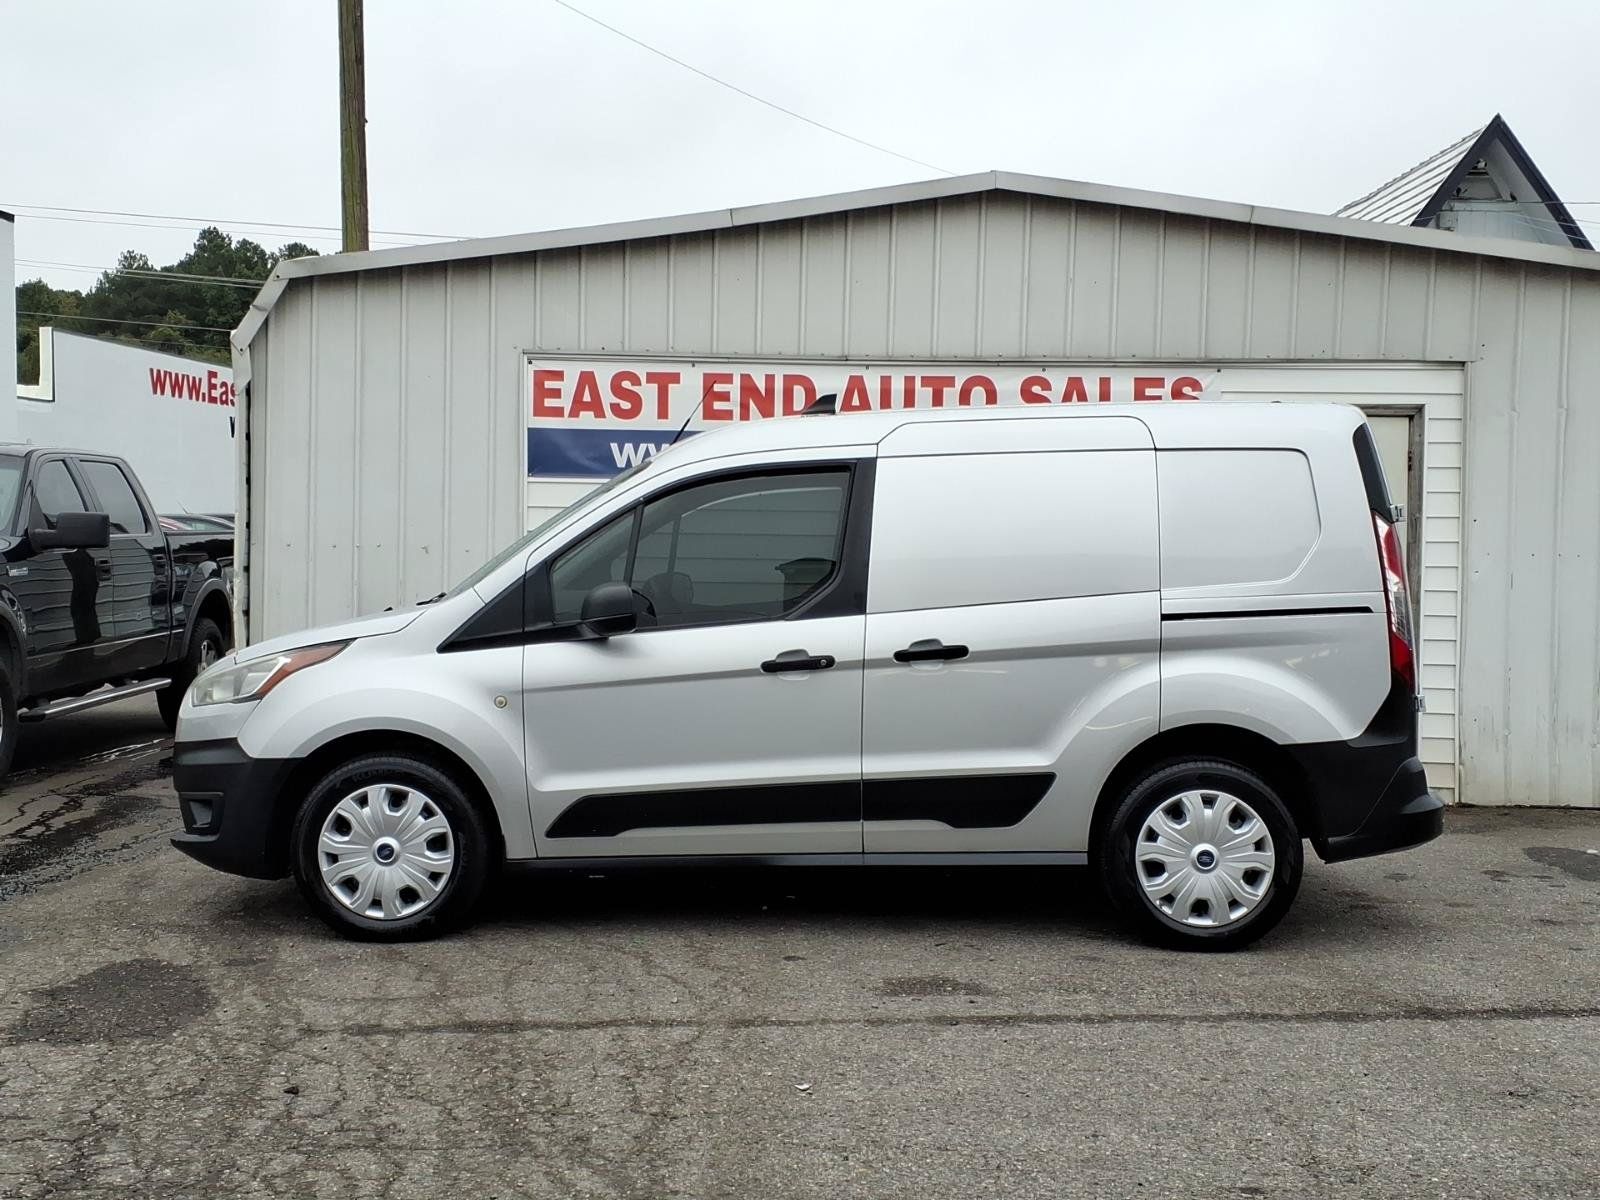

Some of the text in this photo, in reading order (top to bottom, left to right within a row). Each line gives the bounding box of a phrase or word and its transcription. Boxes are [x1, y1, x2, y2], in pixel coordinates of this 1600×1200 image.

[532, 369, 681, 421] EAST
[702, 371, 817, 422] END
[840, 374, 998, 412] AUTO
